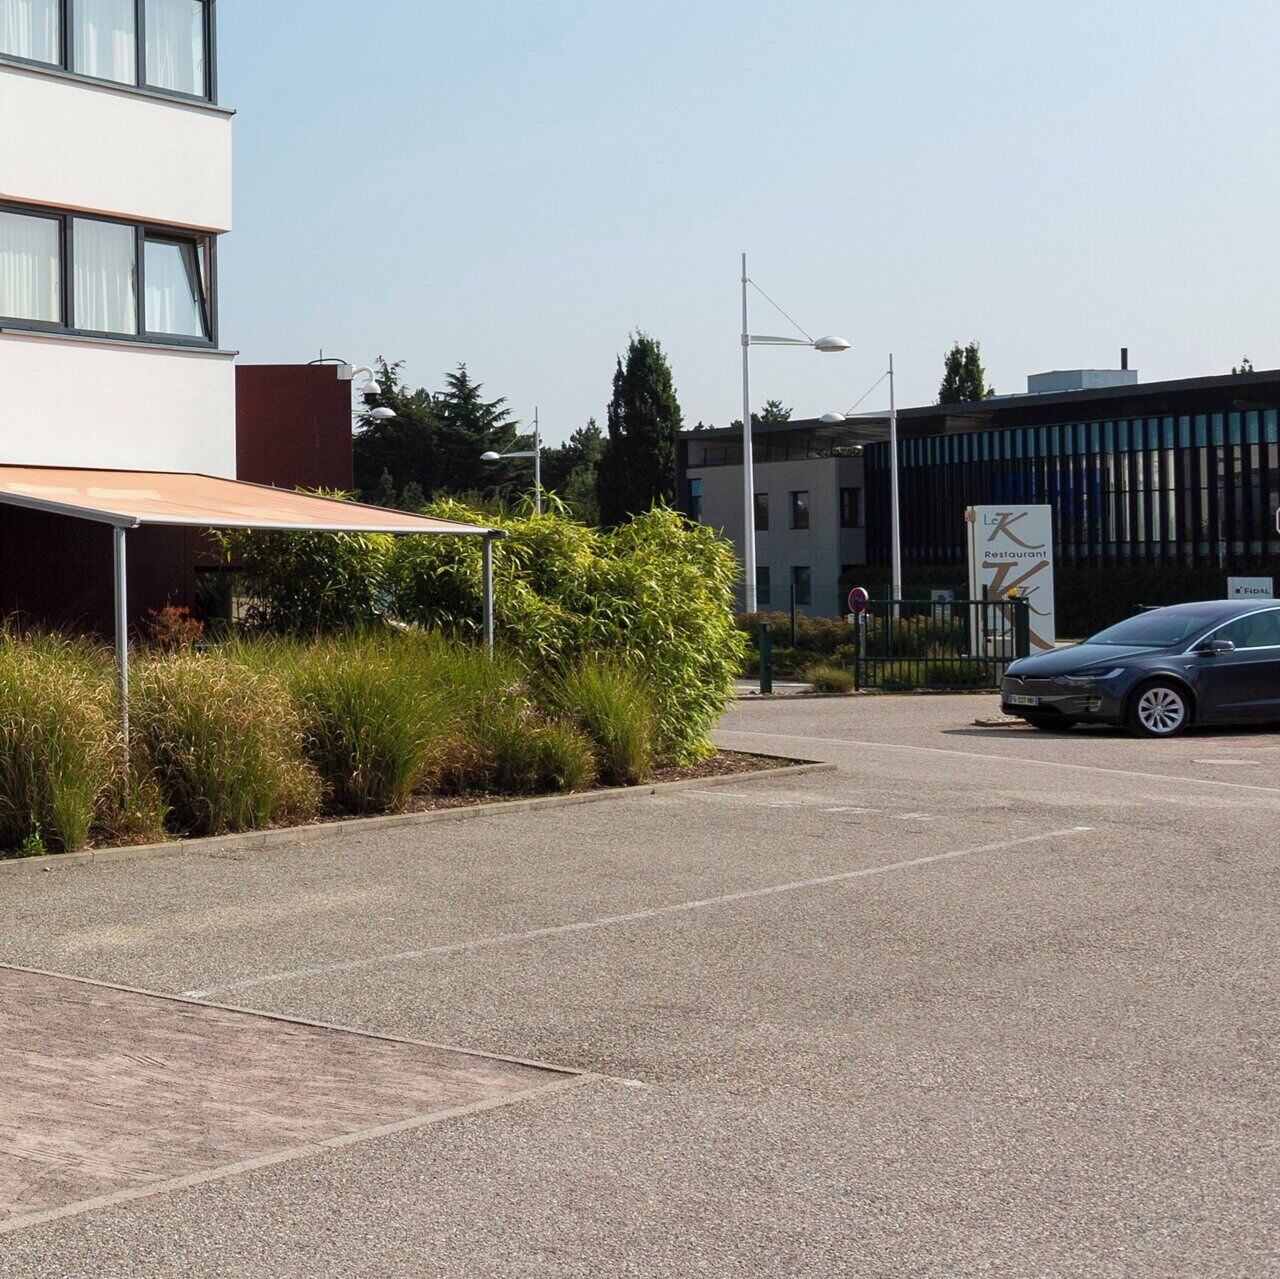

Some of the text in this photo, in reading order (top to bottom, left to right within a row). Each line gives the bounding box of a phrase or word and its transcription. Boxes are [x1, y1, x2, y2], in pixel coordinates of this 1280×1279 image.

[983, 511, 1045, 549] Le K
[984, 550, 1047, 558] Restaurant
